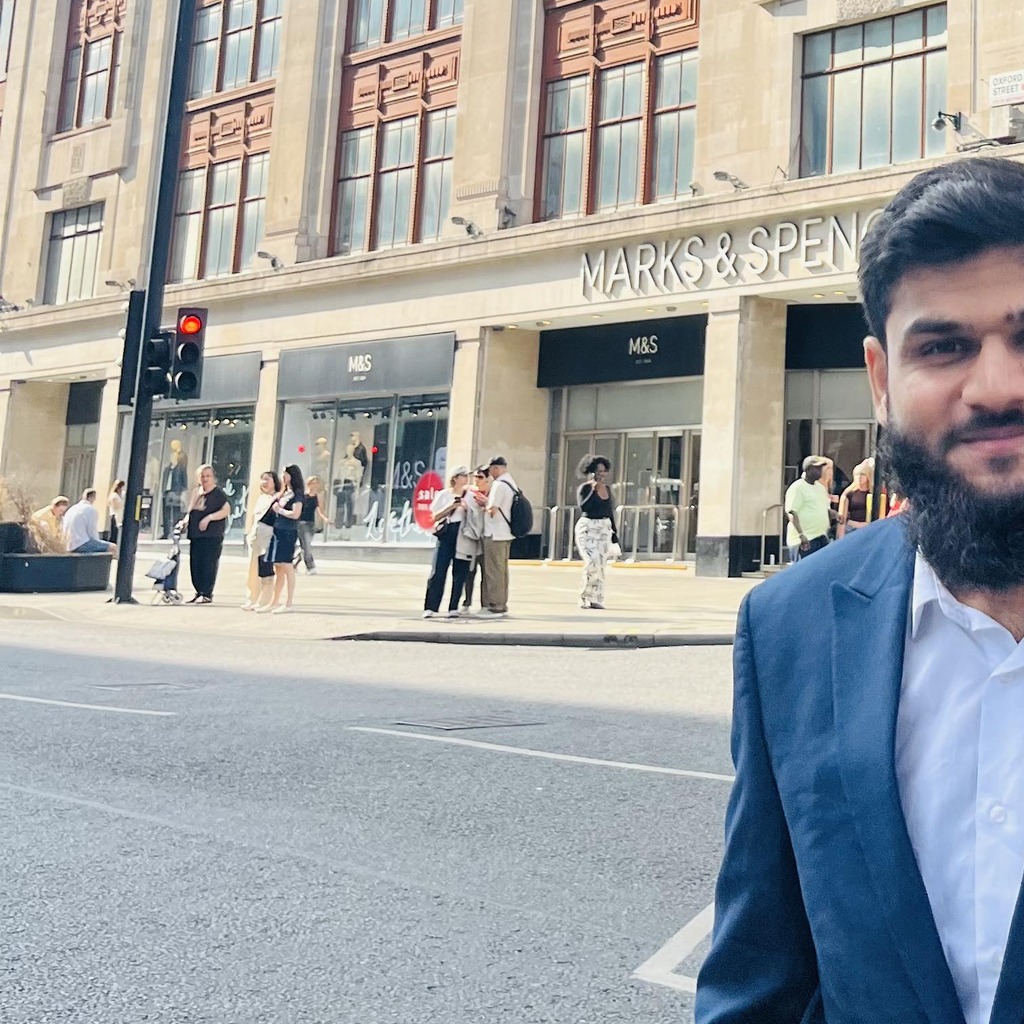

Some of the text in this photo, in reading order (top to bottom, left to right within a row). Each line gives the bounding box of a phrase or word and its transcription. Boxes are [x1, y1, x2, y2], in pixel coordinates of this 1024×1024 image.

[992, 73, 1023, 86] OXFORD
[992, 84, 1019, 96] STREET
[580, 234, 706, 295] MARKS
[715, 231, 739, 279] &
[628, 334, 659, 356] M&S
[348, 353, 372, 373] M&S
